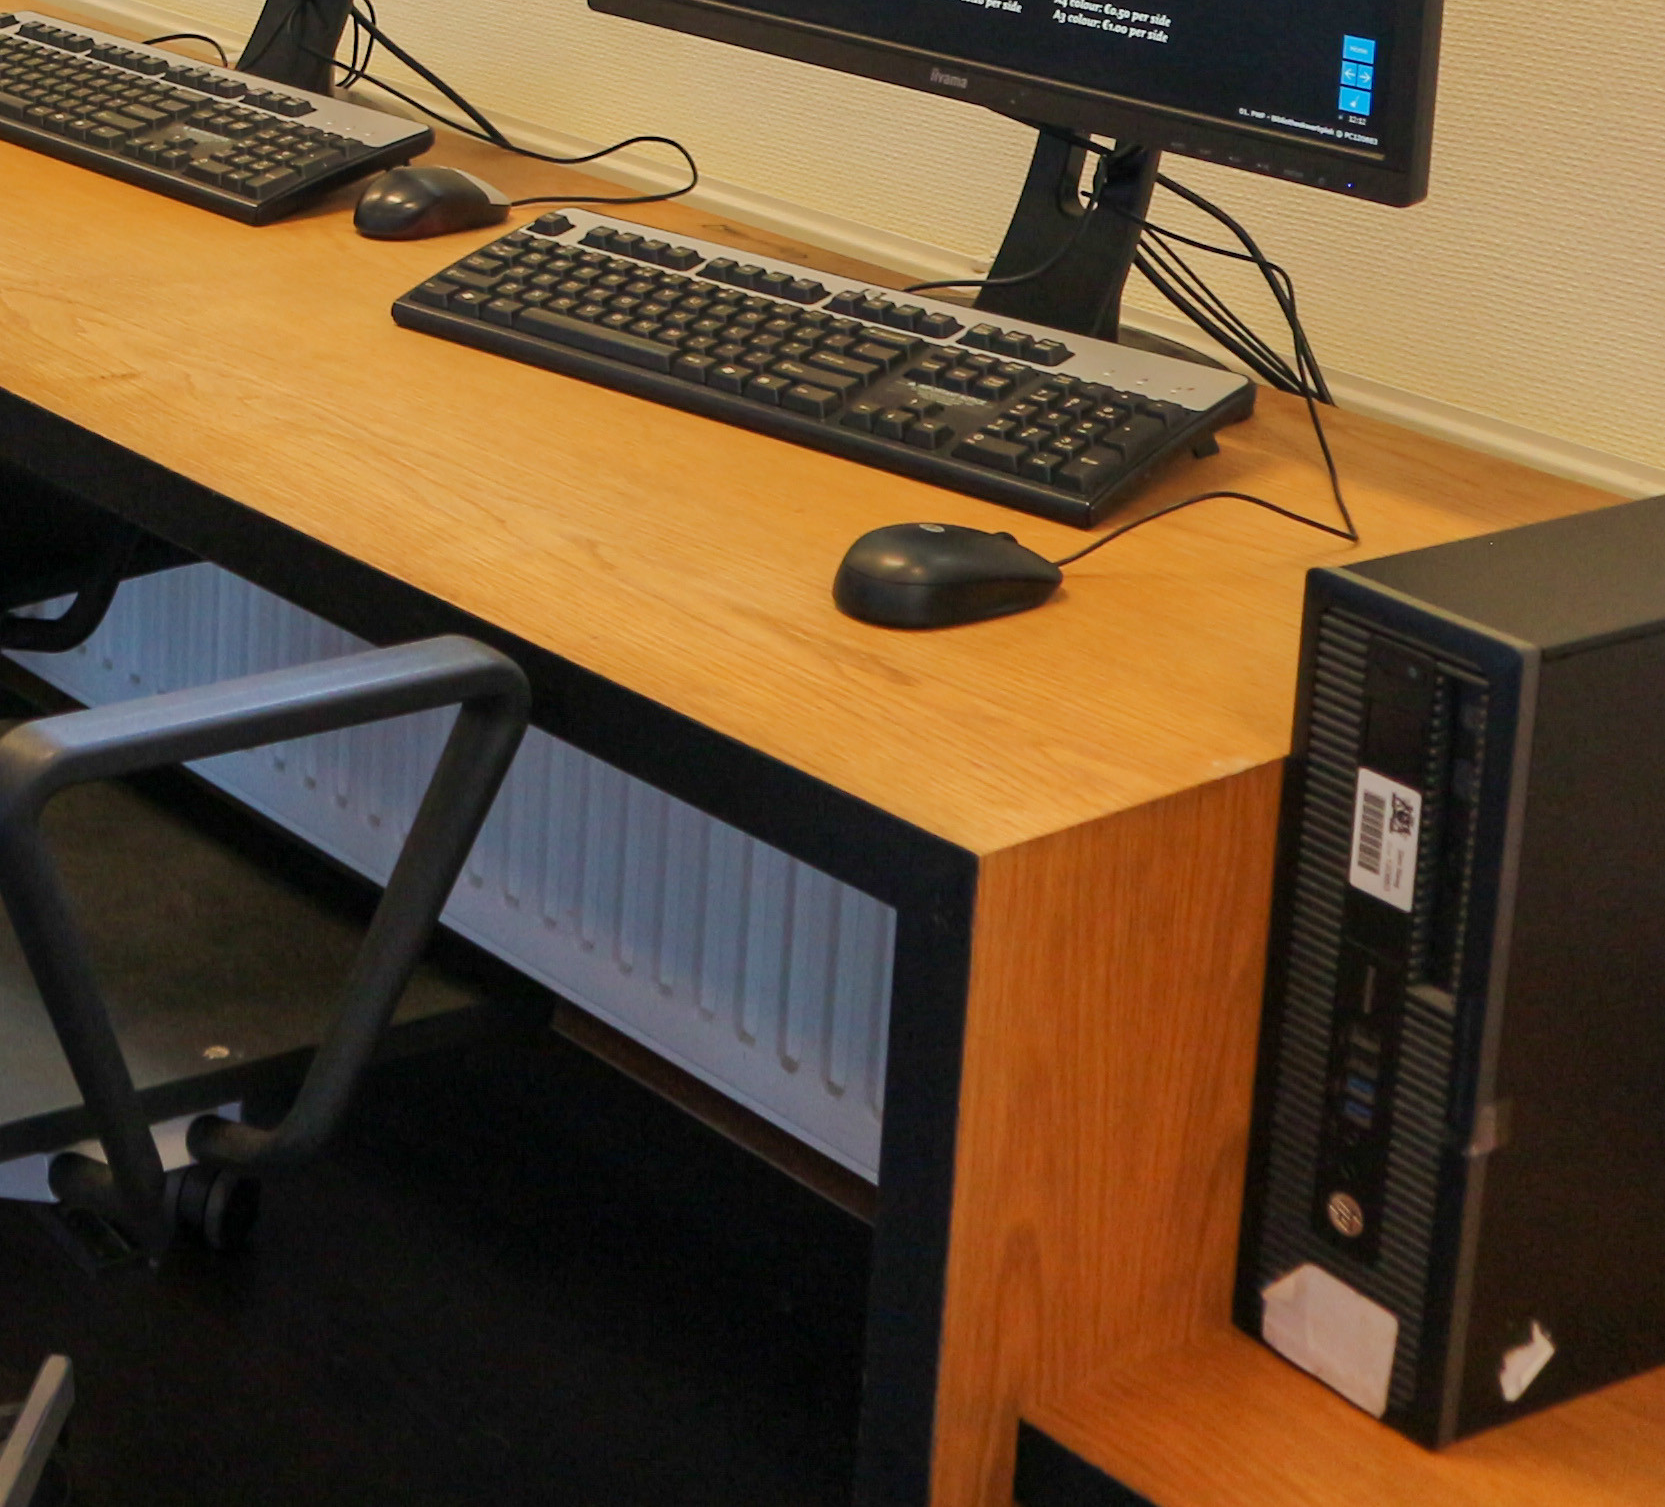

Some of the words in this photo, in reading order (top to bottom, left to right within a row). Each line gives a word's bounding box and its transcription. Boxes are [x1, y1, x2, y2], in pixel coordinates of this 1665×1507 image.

[1002, 0, 1022, 13] side
[1131, 11, 1150, 23] per
[1149, 13, 1171, 27] side
[1128, 27, 1147, 38] per
[1146, 29, 1169, 43] side
